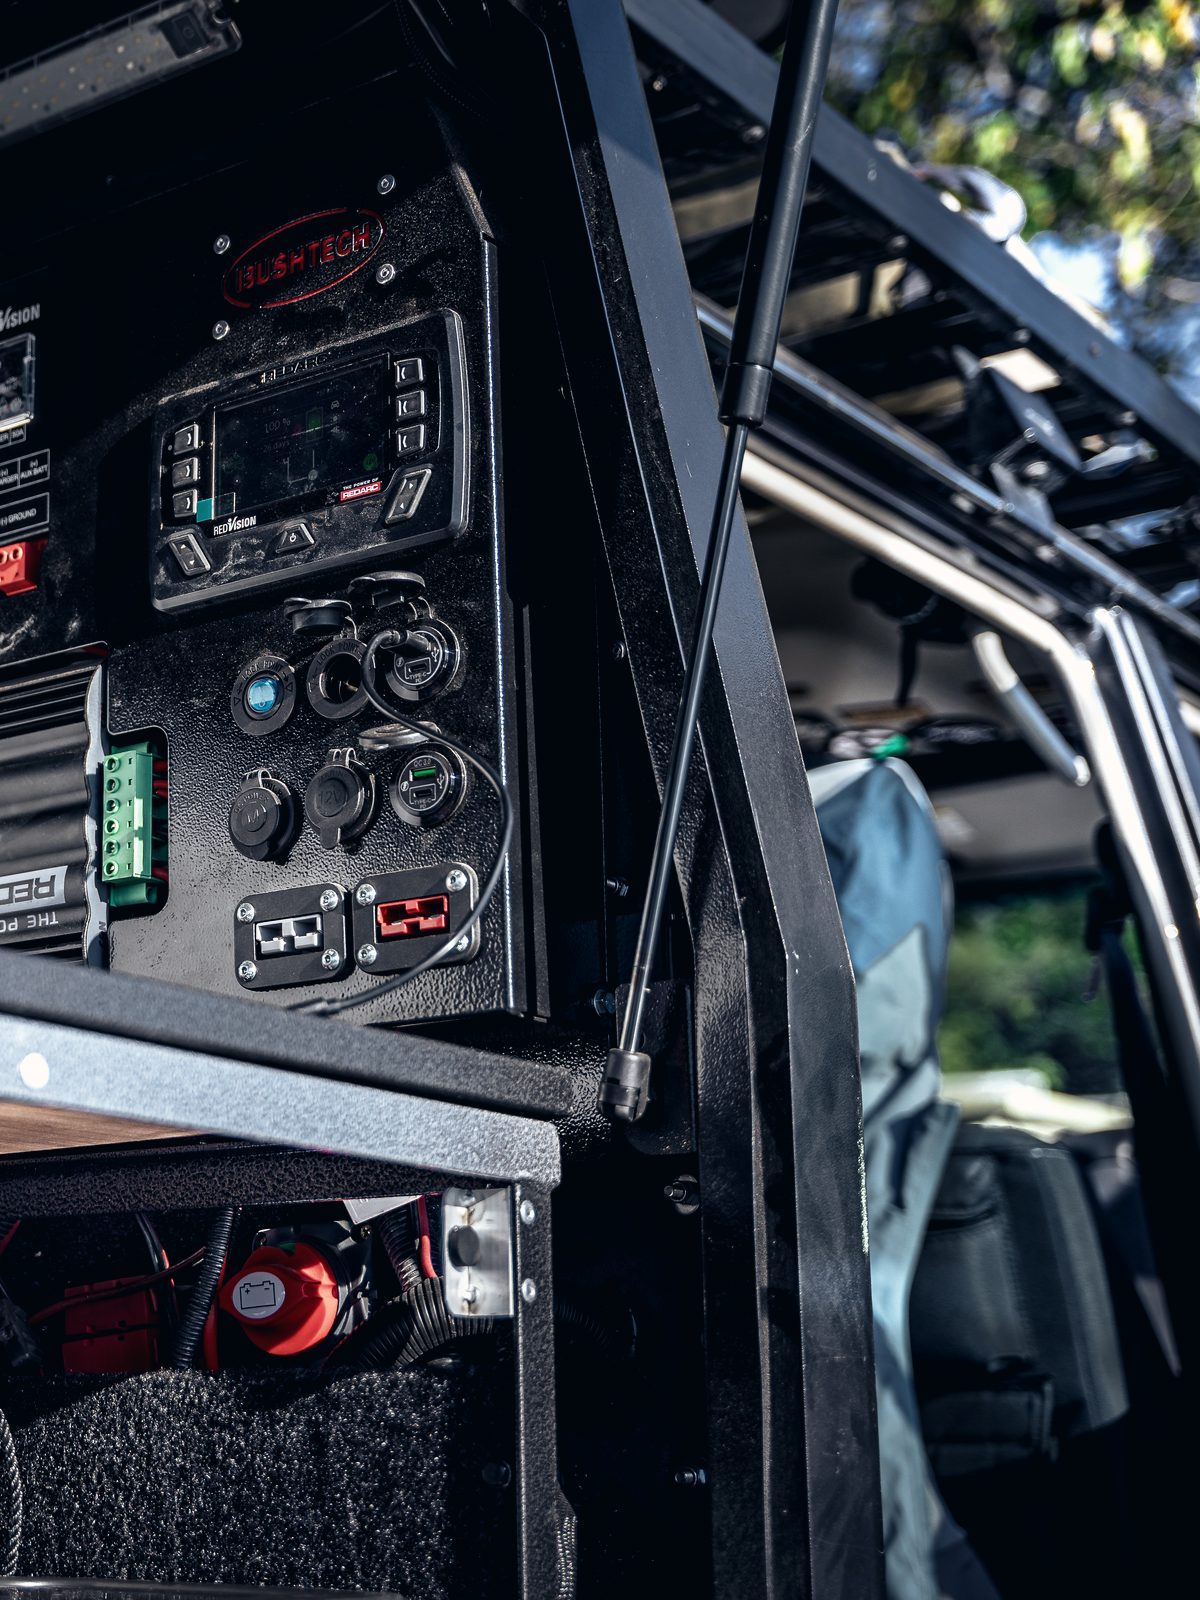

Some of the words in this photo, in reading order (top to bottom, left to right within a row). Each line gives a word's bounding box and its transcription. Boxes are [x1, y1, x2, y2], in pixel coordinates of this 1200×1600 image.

[235, 221, 372, 294] BUSHTECH
[343, 484, 379, 499] REDARC
[353, 479, 371, 488] POWER
[8, 507, 37, 523] GROUND
[241, 662, 260, 681] LOCK
[263, 659, 283, 673] POINT
[27, 911, 59, 928] THE
